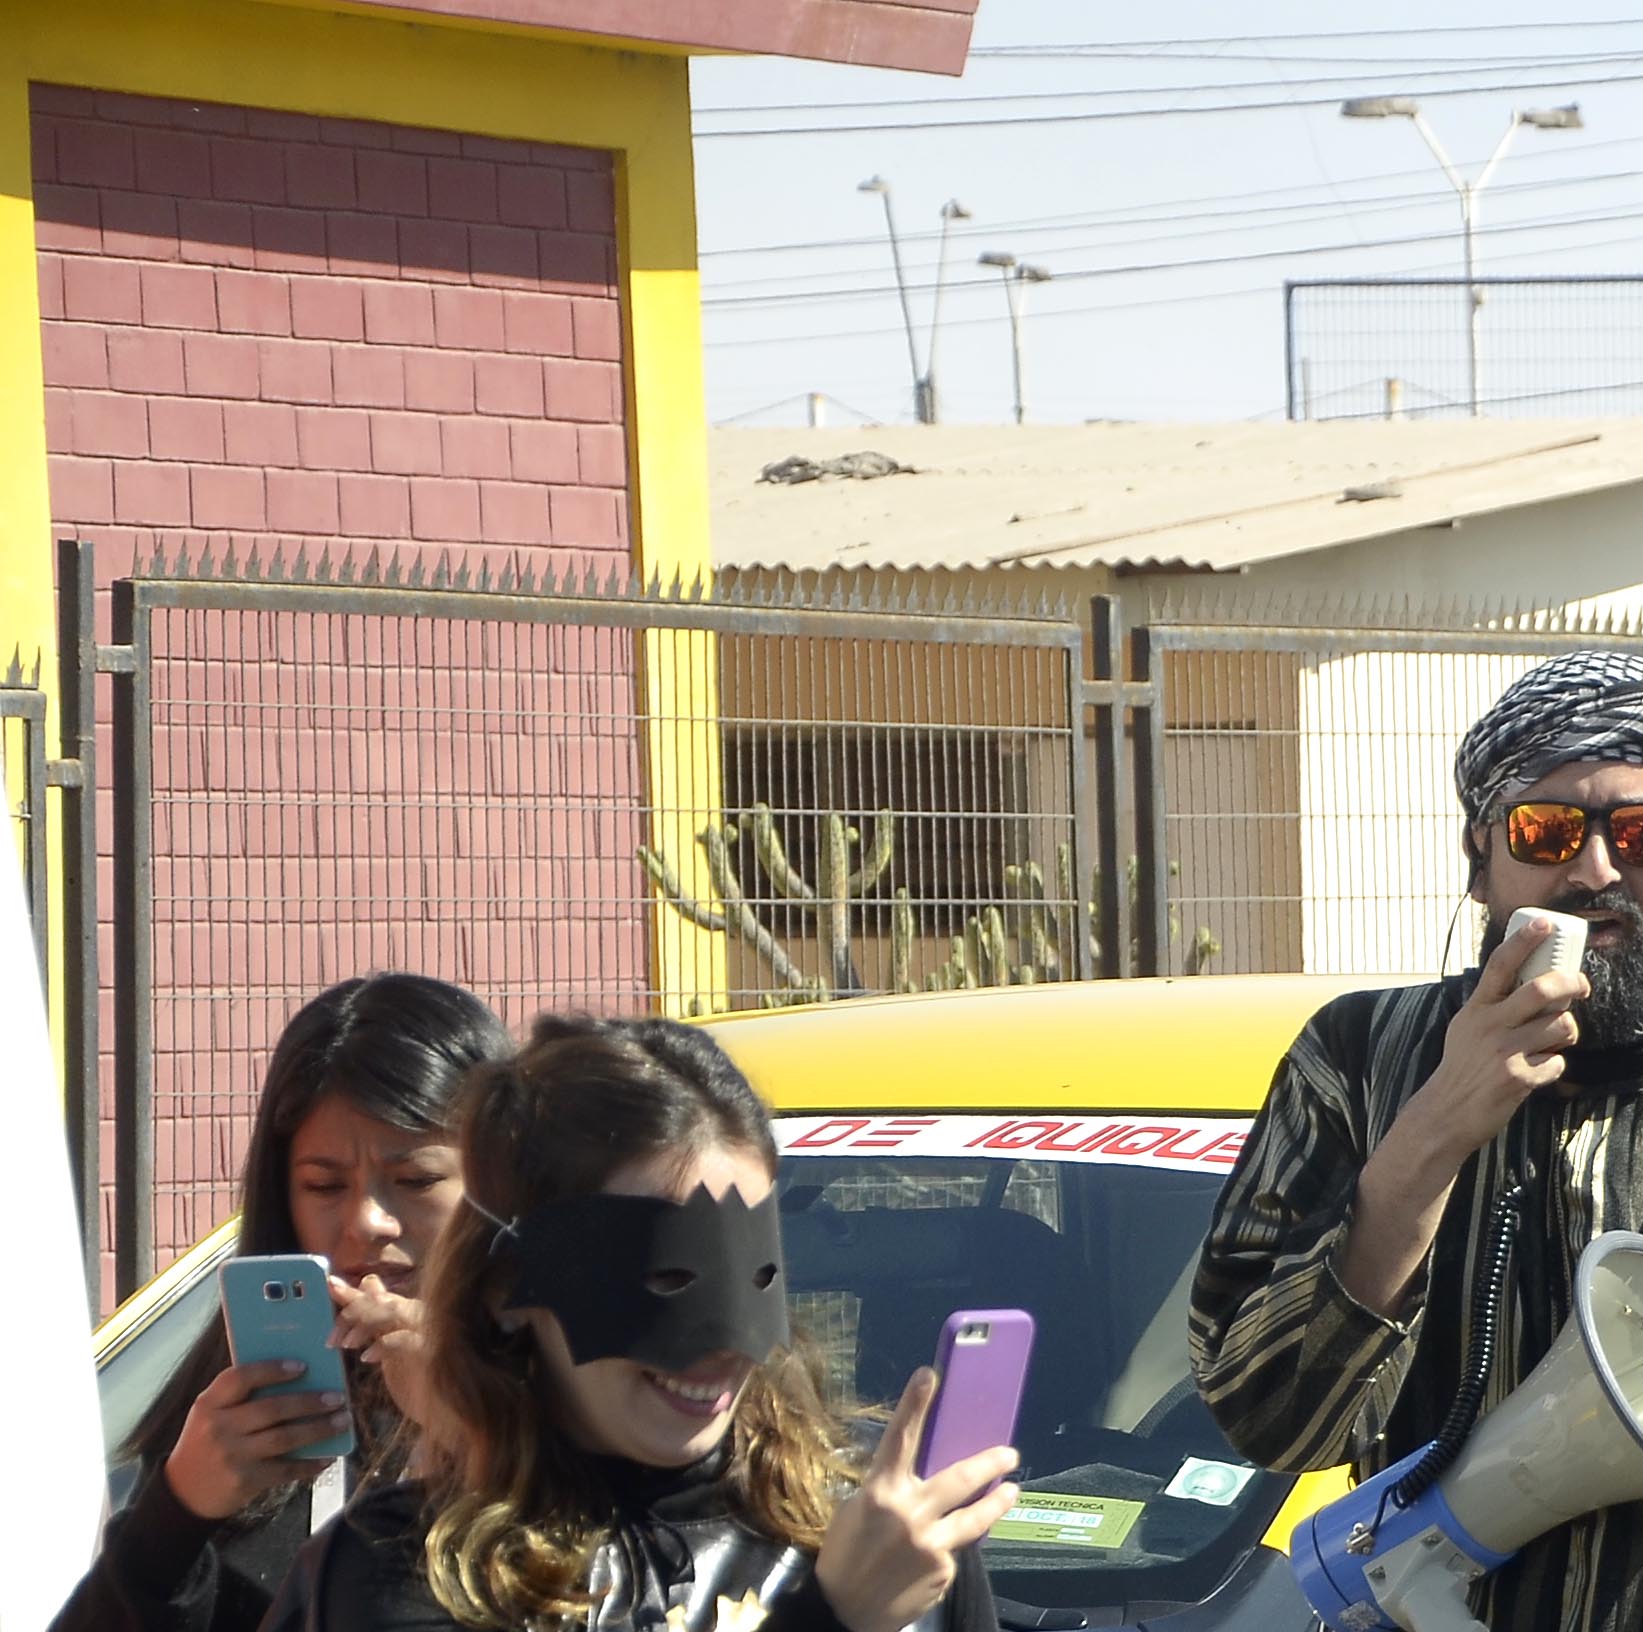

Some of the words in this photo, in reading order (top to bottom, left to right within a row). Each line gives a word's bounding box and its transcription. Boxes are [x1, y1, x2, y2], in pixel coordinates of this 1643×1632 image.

[785, 1118, 941, 1149] DE
[963, 1119, 1248, 1164] IQUIQUE
[1018, 1497, 1056, 1507] VISION
